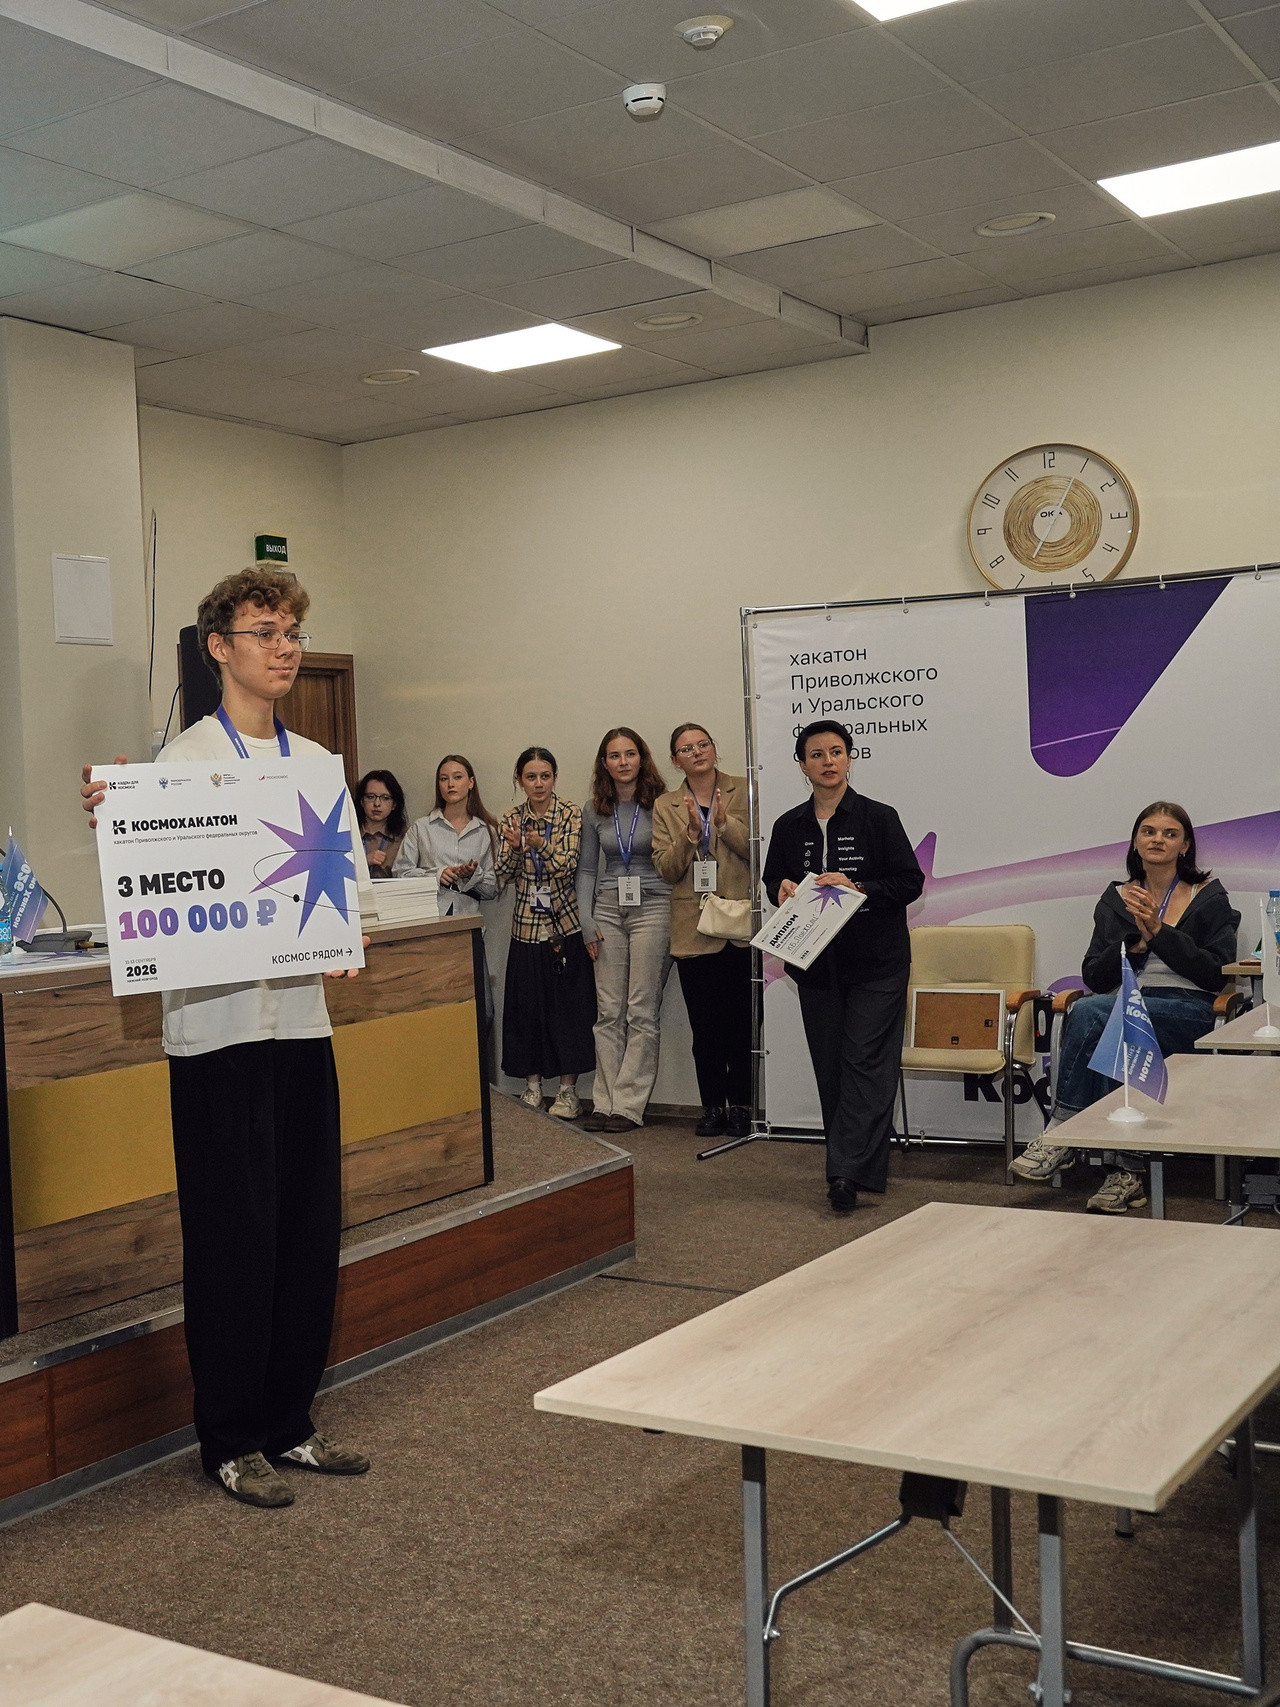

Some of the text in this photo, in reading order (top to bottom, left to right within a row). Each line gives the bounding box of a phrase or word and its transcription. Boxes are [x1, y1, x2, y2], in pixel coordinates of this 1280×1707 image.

[1043, 452, 1056, 469] 12
[265, 544, 287, 555] ВЫХОД
[789, 648, 868, 667] хакатон
[790, 667, 939, 694] Приволжского
[791, 693, 924, 716] и Уральского
[792, 718, 928, 739] фральных
[131, 814, 238, 832] КОСМОХАКАТОН
[113, 837, 135, 845] хакатон
[135, 834, 172, 844] Приволжского
[177, 832, 205, 841] Уральского
[205, 831, 238, 839] федеральных
[239, 829, 258, 837] округов
[117, 868, 226, 898] 3 МЕСТО
[119, 907, 179, 941] 100
[187, 900, 249, 933] 000
[769, 913, 799, 947] ДИПЛОМ
[271, 948, 344, 965] КОСМОС РЯДОМ
[126, 963, 157, 977] 2026
